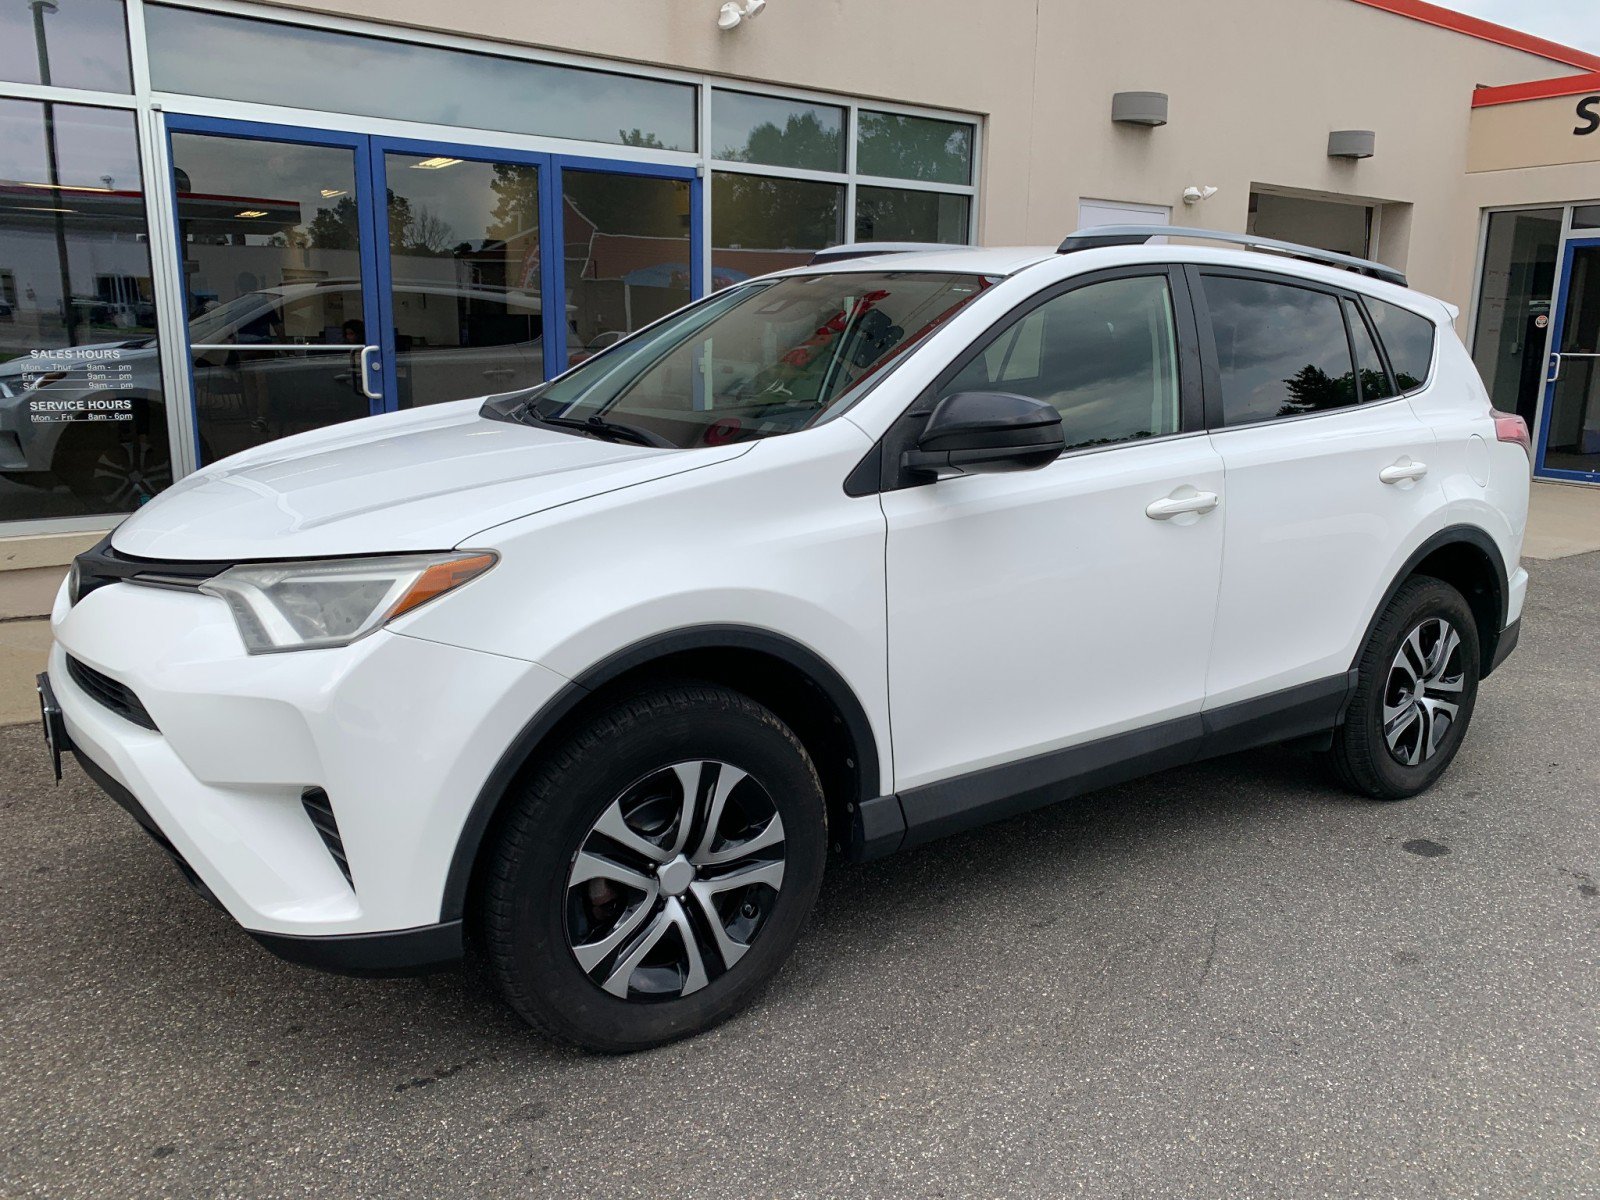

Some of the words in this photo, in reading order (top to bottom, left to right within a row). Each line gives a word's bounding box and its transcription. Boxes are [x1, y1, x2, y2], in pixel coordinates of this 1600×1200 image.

[30, 349, 72, 359] SALES
[76, 349, 120, 359] HOURS
[20, 363, 43, 371] Mon.
[51, 363, 74, 371] Thur.
[86, 363, 106, 371] 9am
[87, 372, 107, 380] 9am
[88, 381, 108, 390] 9am
[120, 382, 134, 390] pm
[29, 401, 85, 411] SERVICE
[87, 400, 132, 410] HOURS
[61, 413, 75, 421] Fri.
[87, 413, 107, 421] 8am
[114, 412, 133, 421] 6pm
